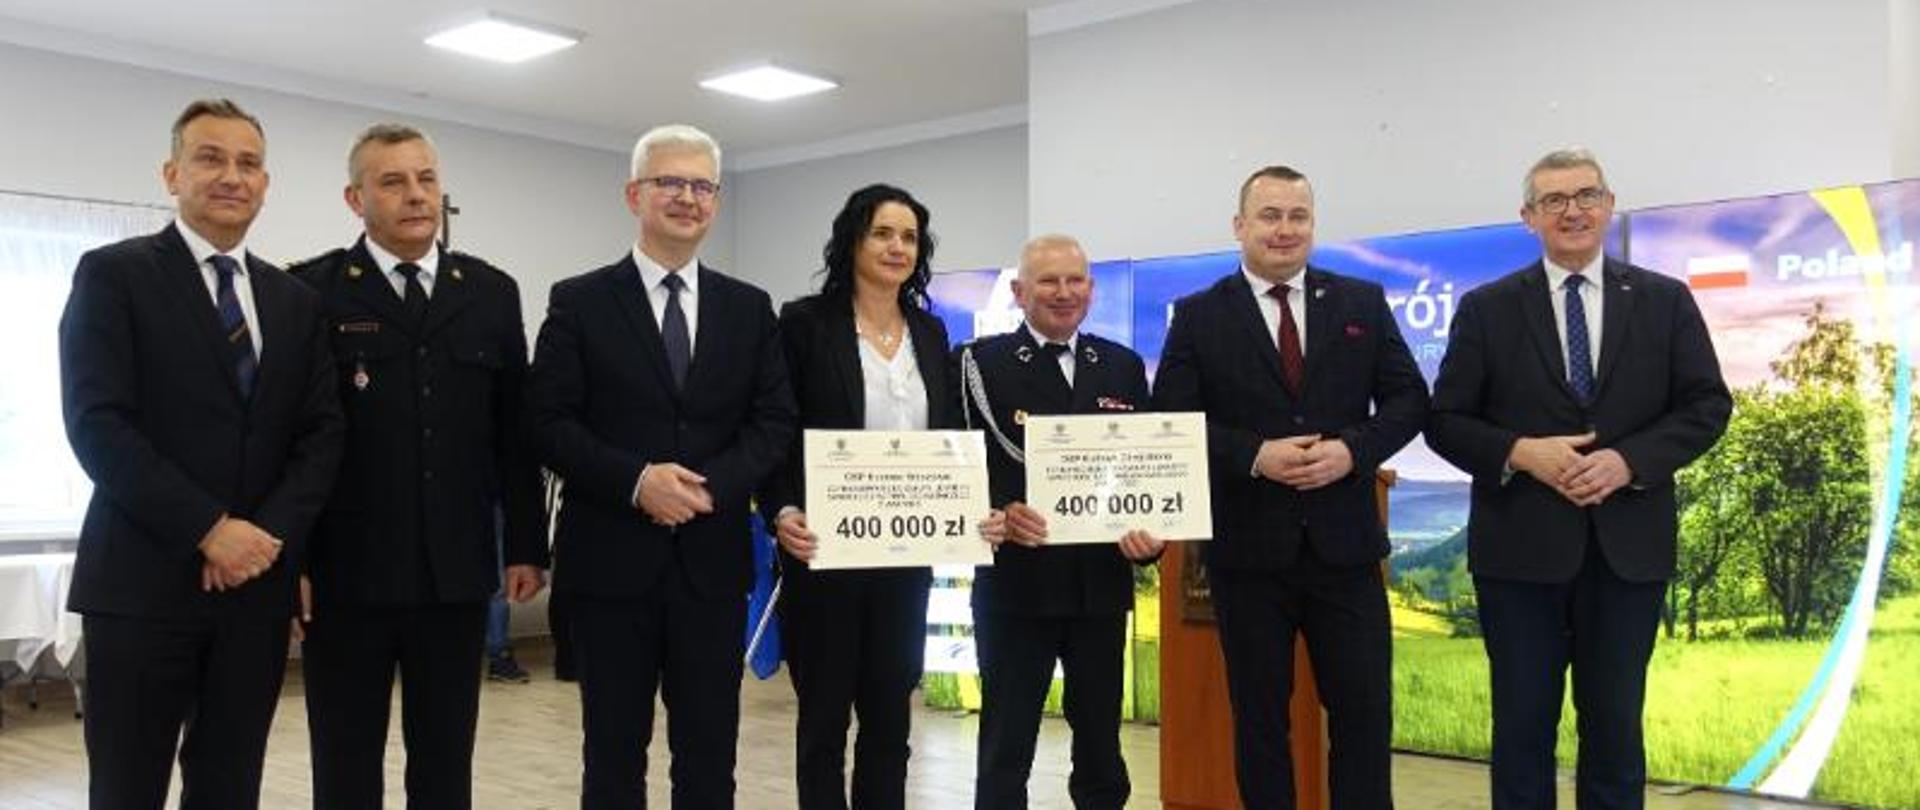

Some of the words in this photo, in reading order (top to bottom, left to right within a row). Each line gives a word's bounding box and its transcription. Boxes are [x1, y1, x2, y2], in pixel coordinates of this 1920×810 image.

[1778, 242, 1913, 280] Poland
[1055, 495, 1098, 516] 400
[1108, 493, 1153, 515] 000
[1162, 491, 1183, 514] zł
[836, 516, 882, 539] 400
[891, 515, 937, 538] 000
[945, 515, 965, 537] zł
